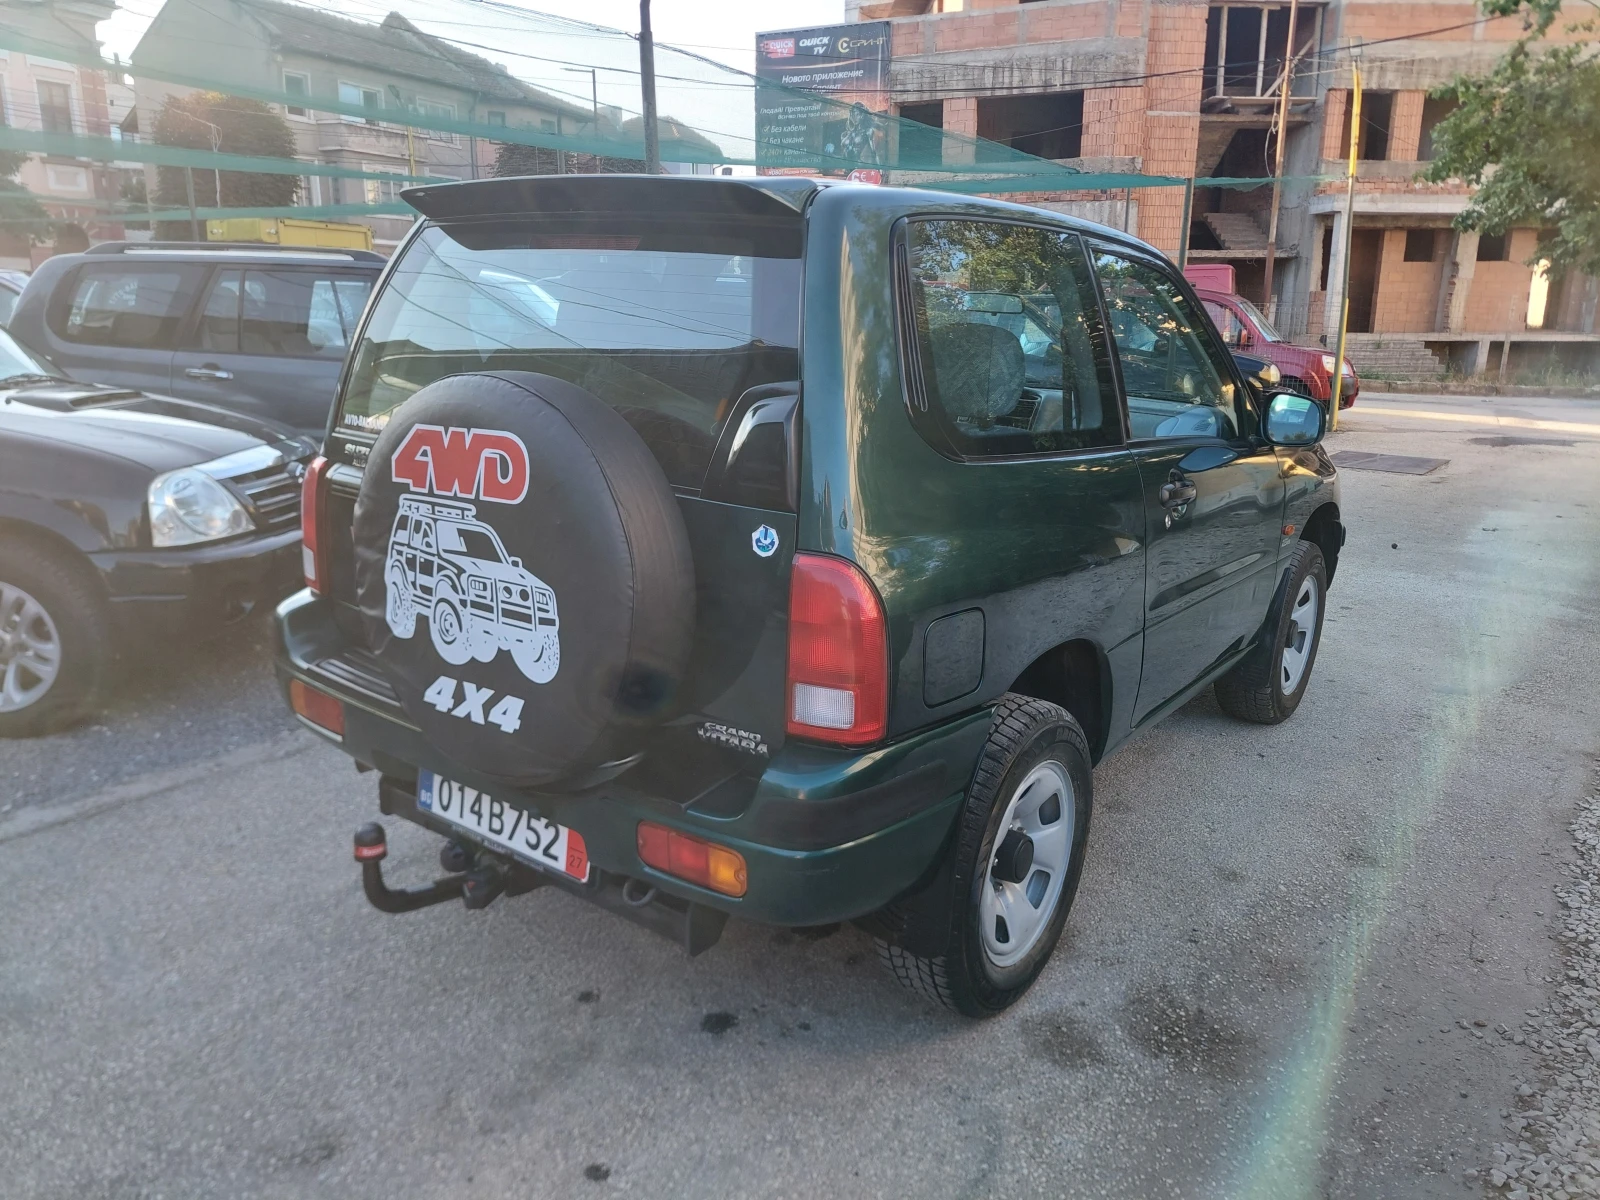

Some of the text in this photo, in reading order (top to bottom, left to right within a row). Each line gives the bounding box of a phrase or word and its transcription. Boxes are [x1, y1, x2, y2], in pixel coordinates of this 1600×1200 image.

[770, 40, 793, 49] QUICK
[799, 36, 830, 46] QUICK
[814, 46, 827, 55] TV
[782, 69, 864, 84] Новото приложение
[783, 124, 807, 132] кабели
[392, 424, 530, 504] 4WD
[423, 675, 525, 733] 4X4
[704, 722, 761, 742] GRAND
[697, 727, 769, 758] VITARA
[438, 779, 560, 862] 014B752
[569, 854, 583, 869] 27
